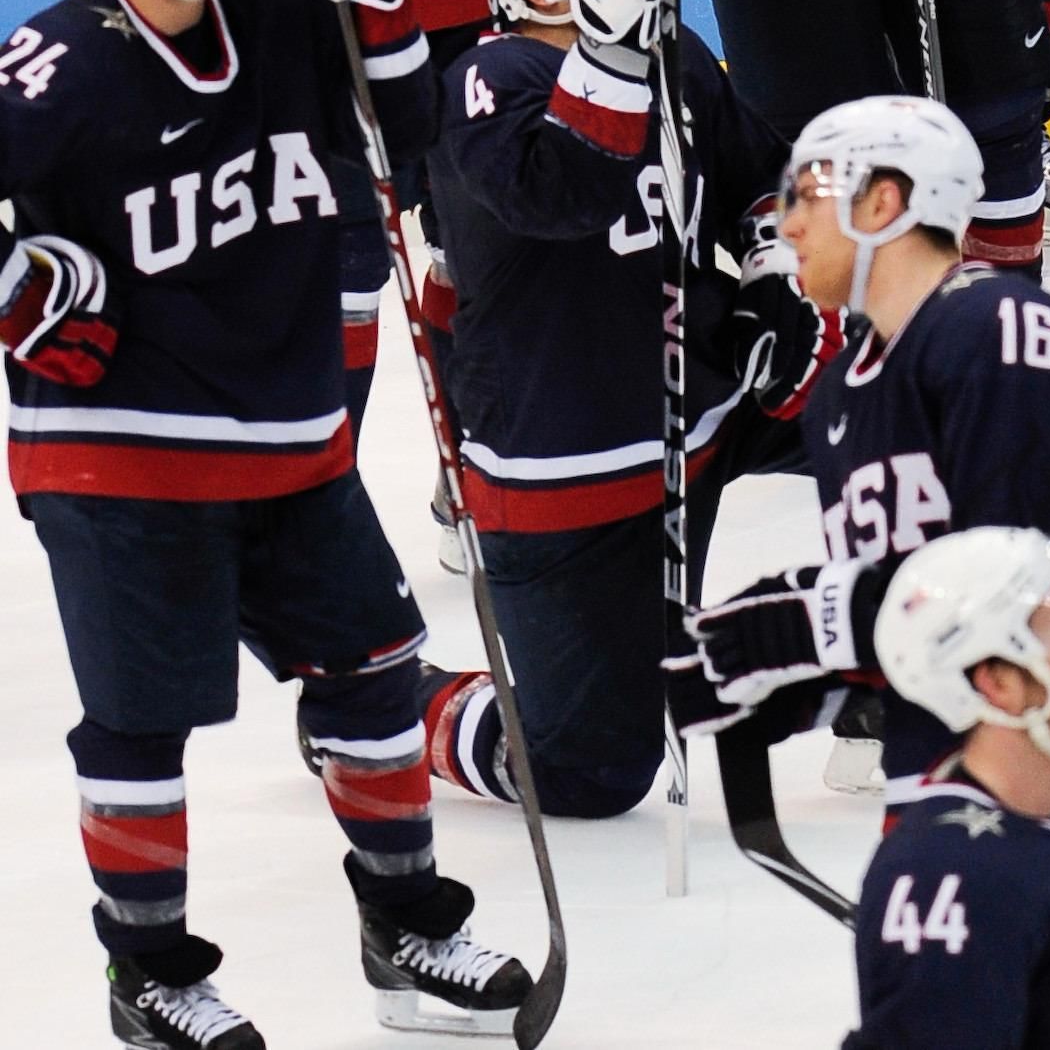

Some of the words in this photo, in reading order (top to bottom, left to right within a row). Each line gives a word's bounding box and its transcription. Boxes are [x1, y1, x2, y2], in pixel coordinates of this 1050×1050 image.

[0, 26, 69, 100] 24
[464, 64, 496, 119] 4
[124, 131, 339, 276] USA
[662, 281, 687, 607] EASTON
[822, 583, 839, 649] USA
[881, 874, 970, 955] 44
